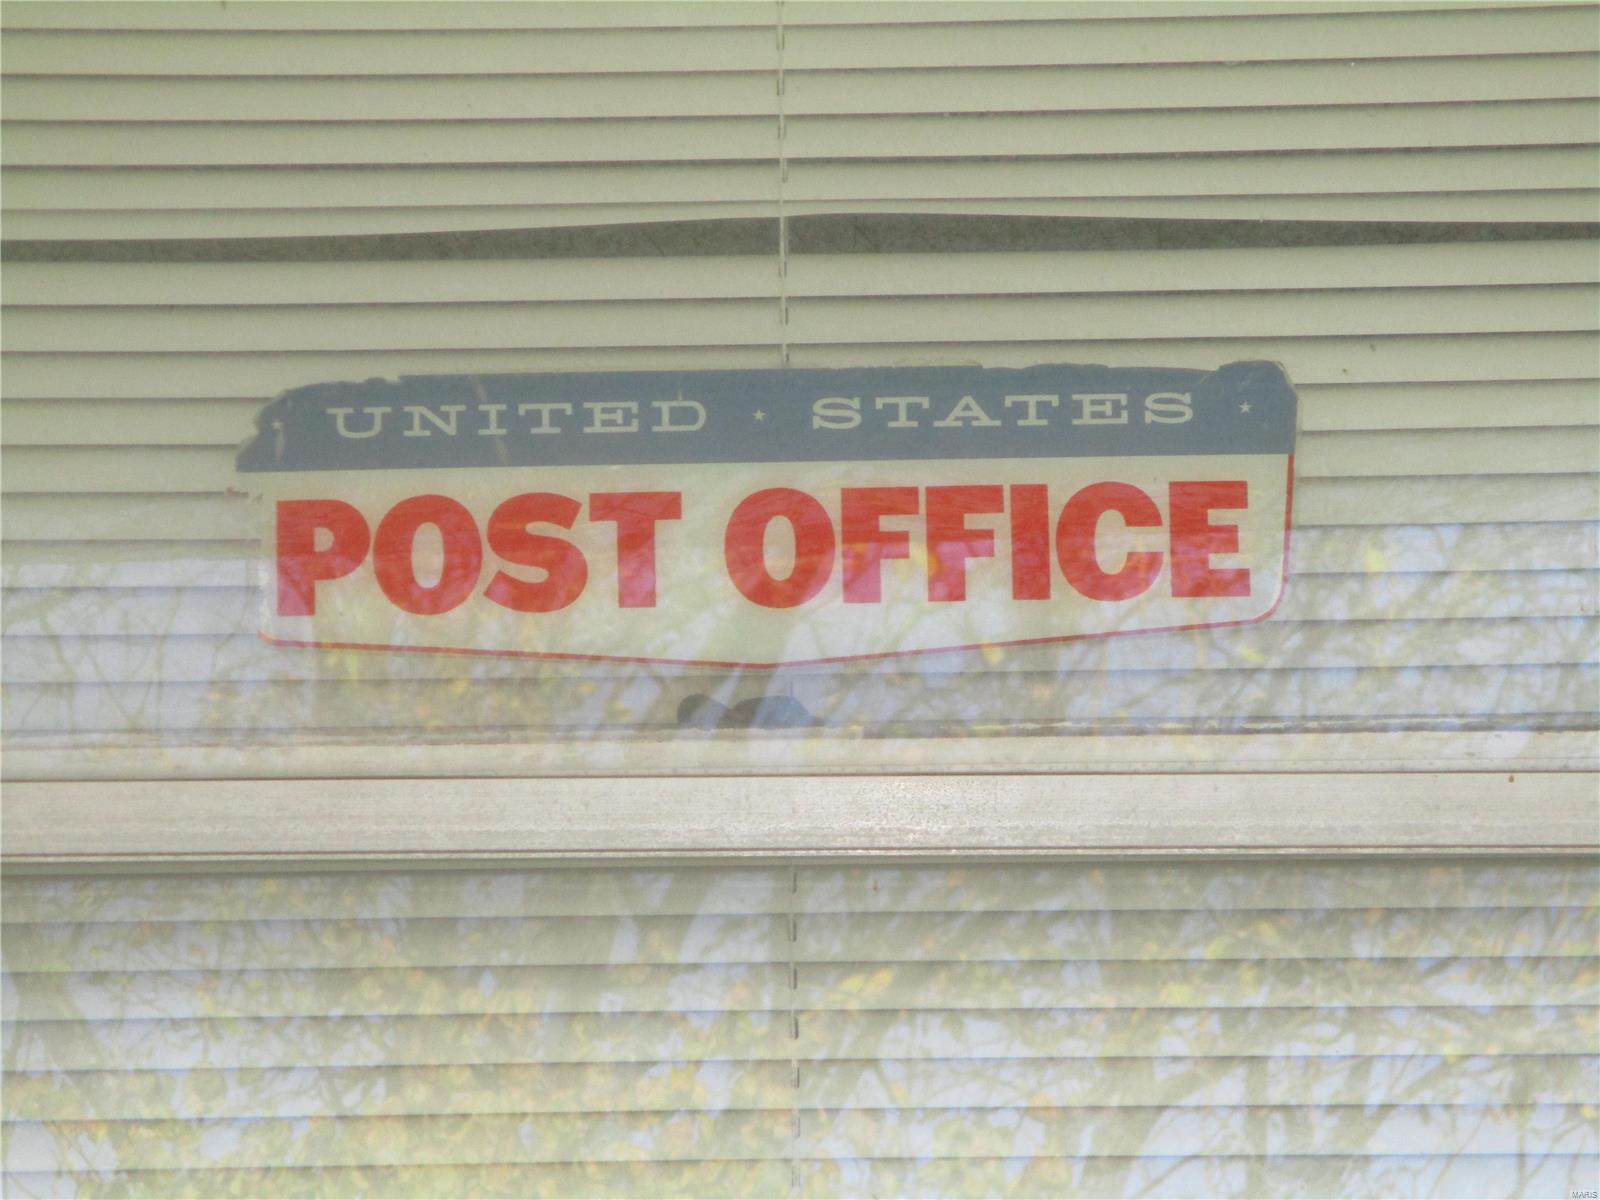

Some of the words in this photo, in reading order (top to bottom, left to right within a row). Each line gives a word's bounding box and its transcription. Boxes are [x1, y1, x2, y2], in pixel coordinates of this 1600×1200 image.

[326, 399, 707, 438] UNITED
[812, 391, 1194, 430] STATES
[276, 491, 683, 617] POST
[724, 480, 1252, 608] OFFICE
